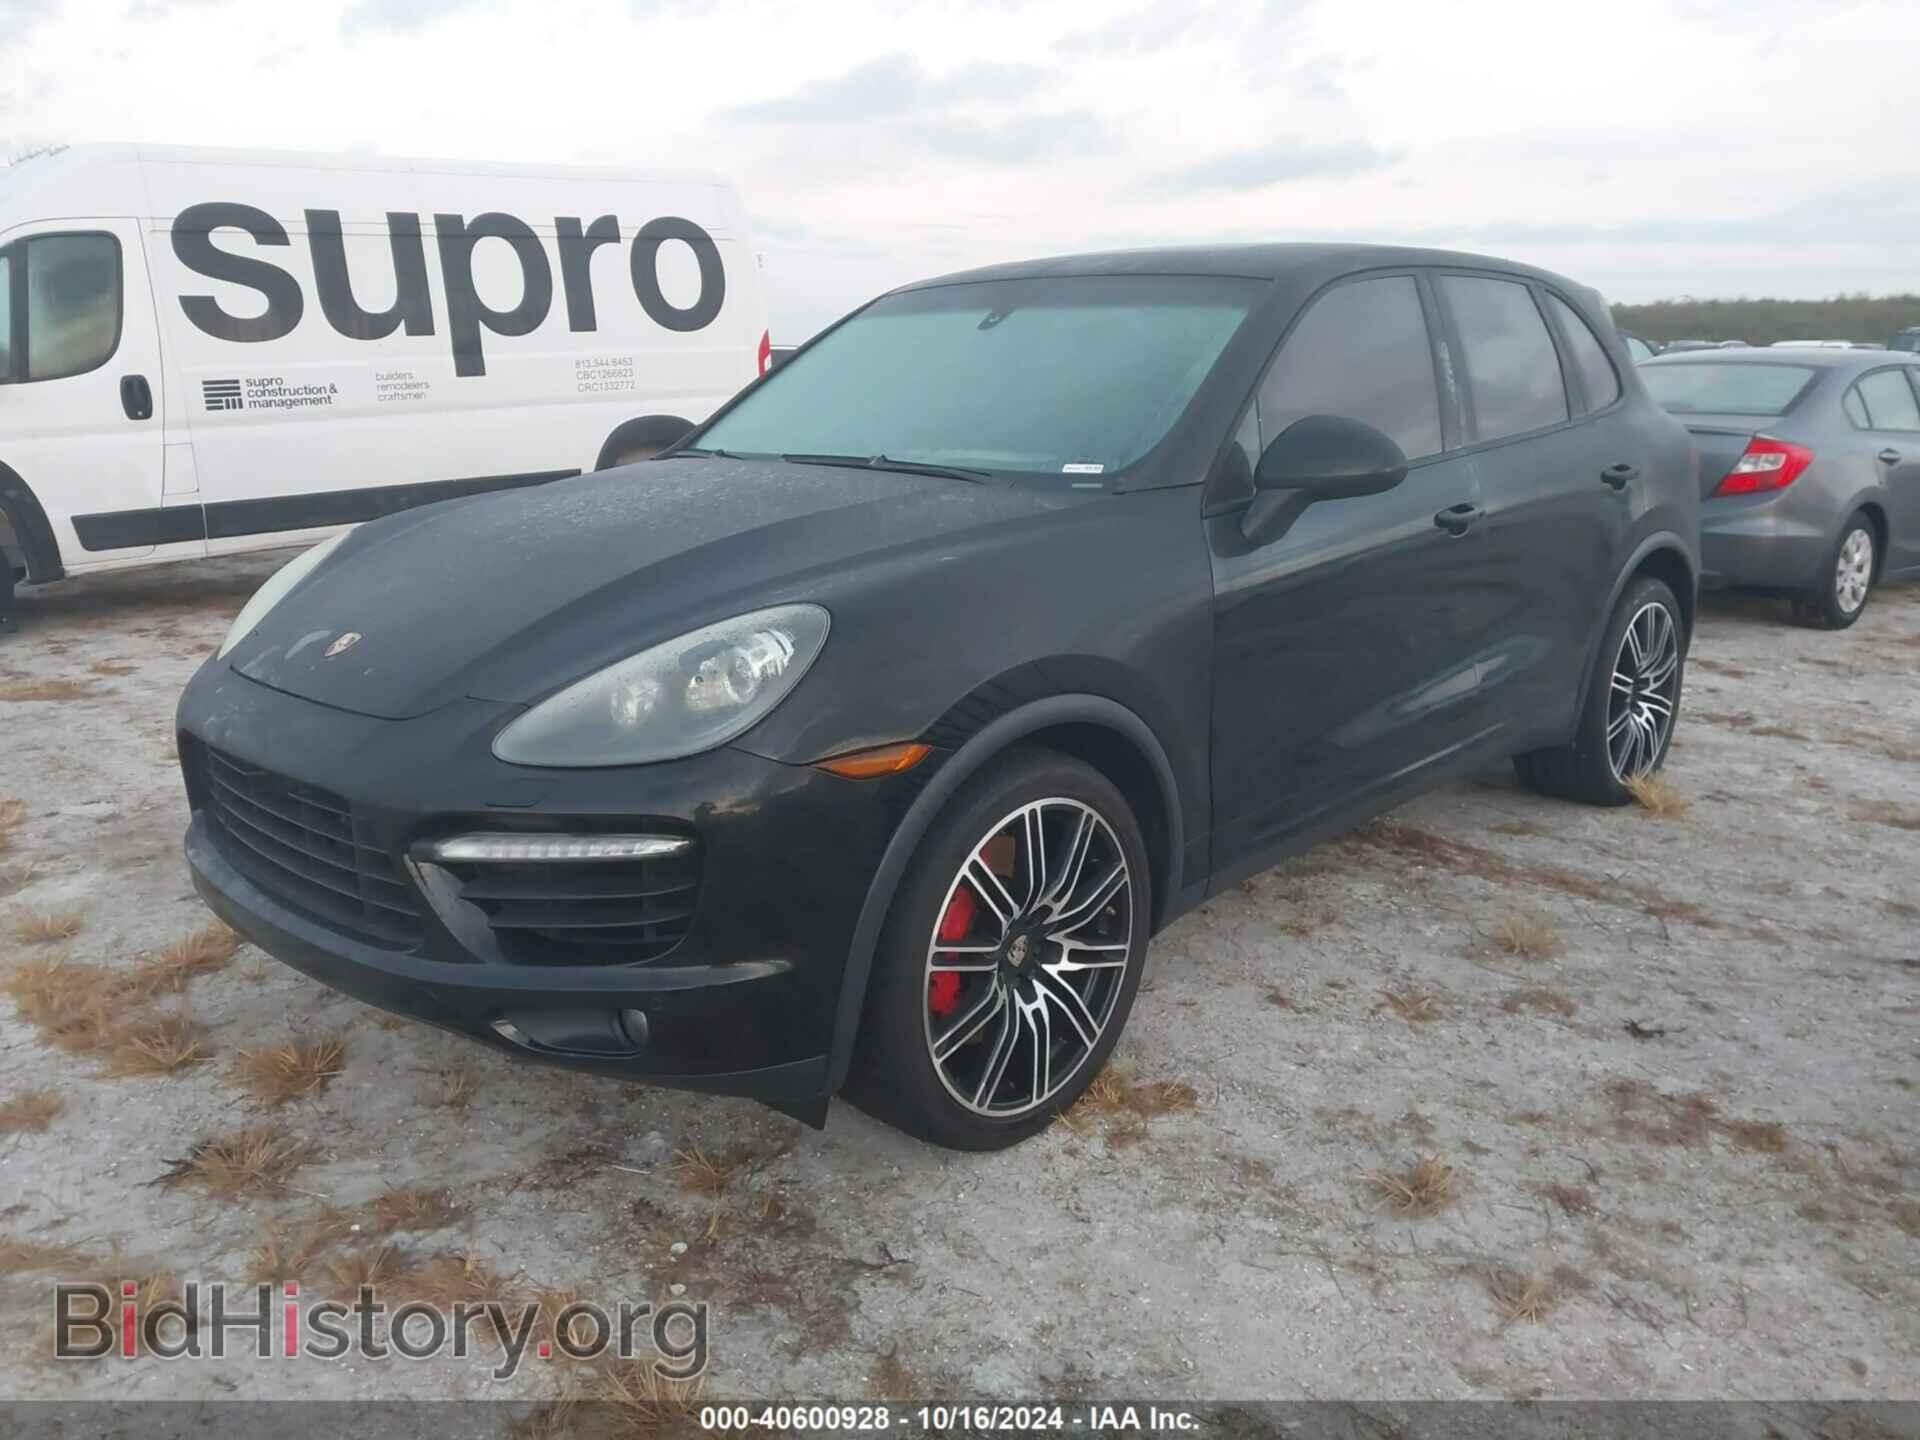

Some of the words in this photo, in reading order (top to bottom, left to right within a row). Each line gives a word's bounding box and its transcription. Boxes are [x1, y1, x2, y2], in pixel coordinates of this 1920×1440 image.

[170, 202, 726, 377] supro
[375, 371, 414, 381] builders
[245, 377, 284, 388] supro
[376, 381, 430, 391] remodelers
[247, 385, 327, 398] construction
[329, 382, 338, 394] &
[377, 391, 426, 402] craftsmen
[248, 395, 332, 410] management
